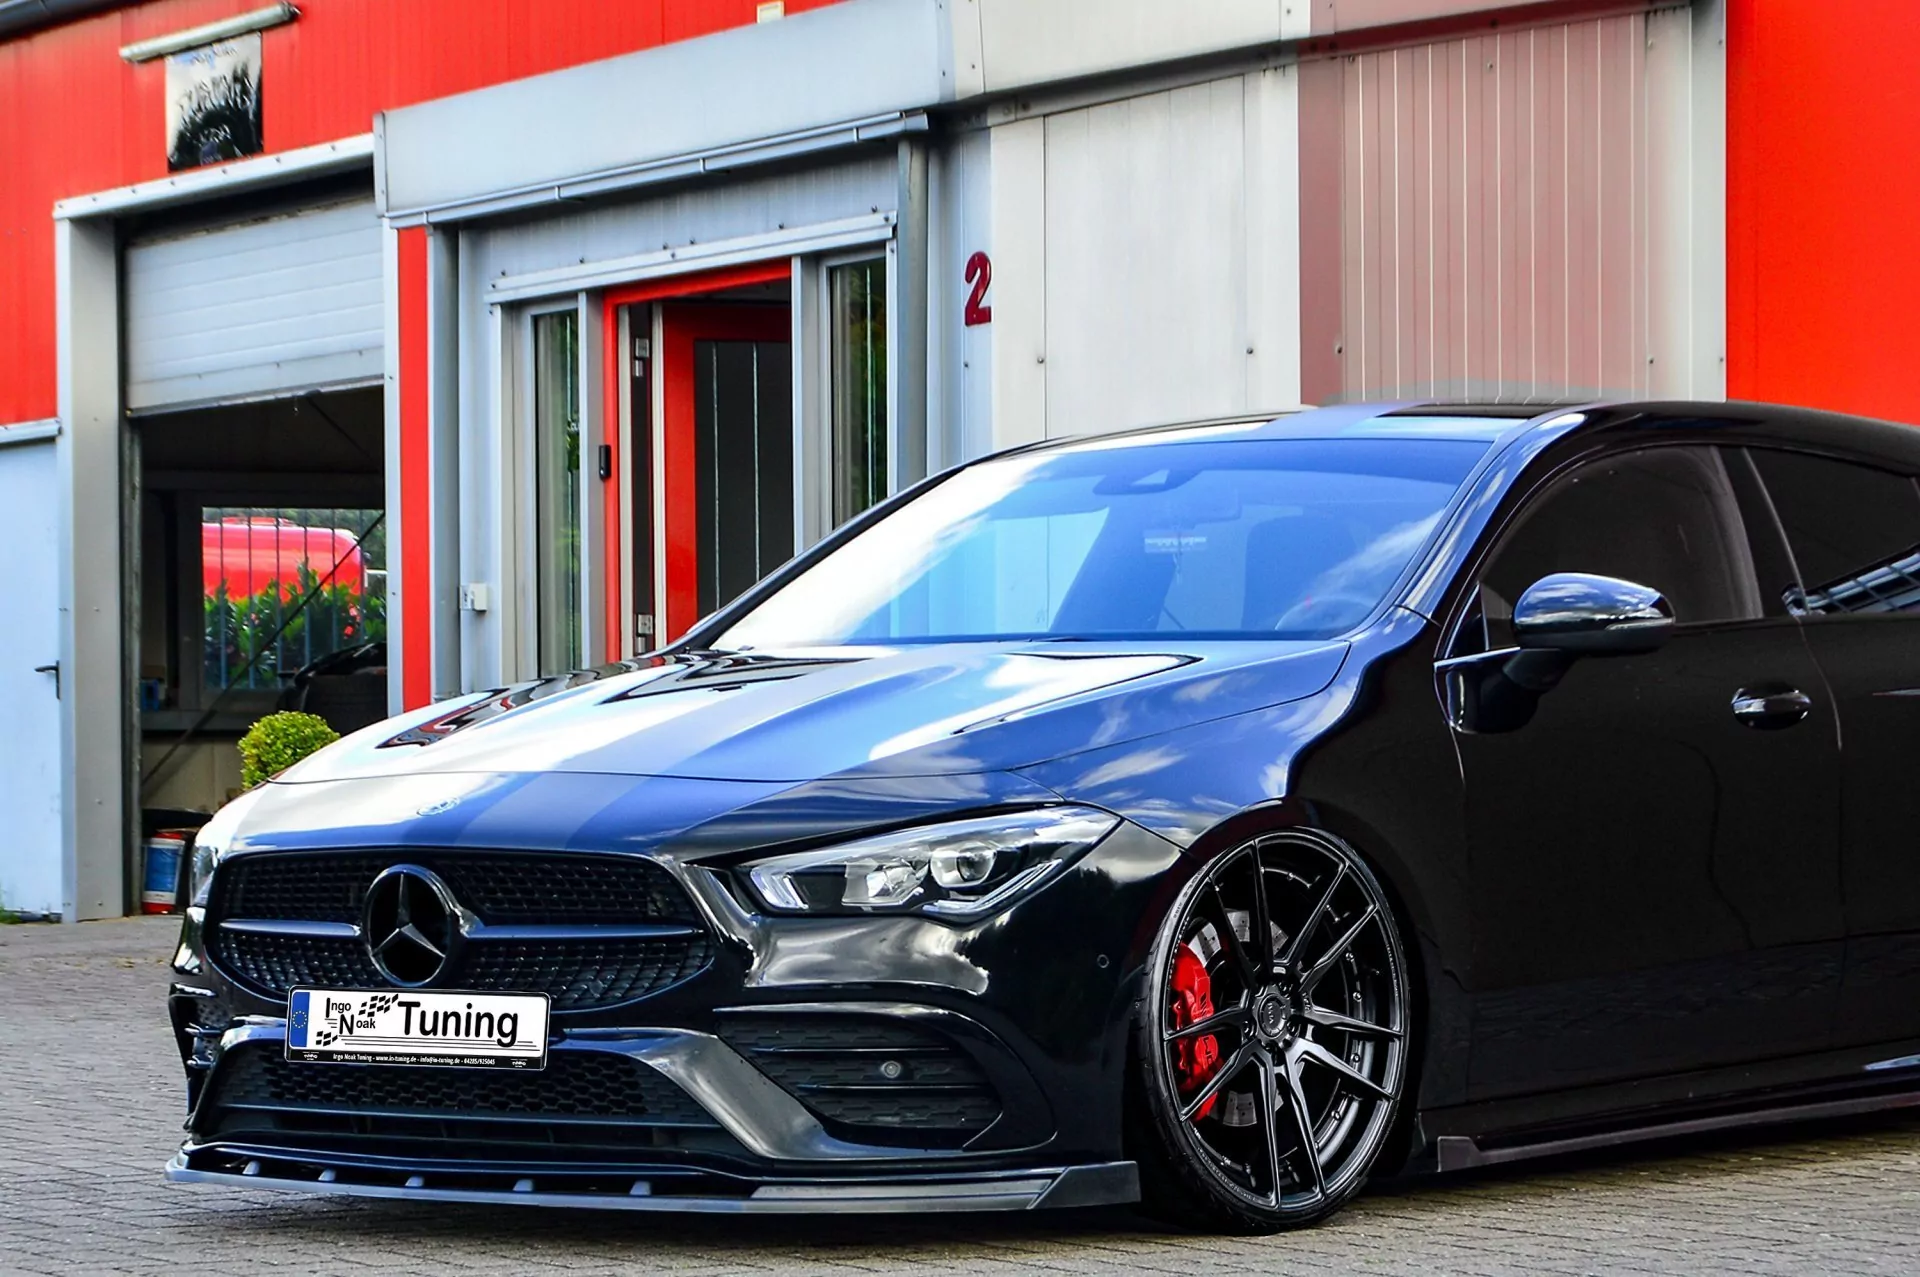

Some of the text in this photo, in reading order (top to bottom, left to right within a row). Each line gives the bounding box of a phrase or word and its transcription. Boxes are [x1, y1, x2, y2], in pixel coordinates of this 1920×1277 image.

[964, 250, 992, 328] 2
[325, 997, 352, 1018] Ingo
[339, 1014, 376, 1035] Noak
[397, 1001, 518, 1048] Tuning
